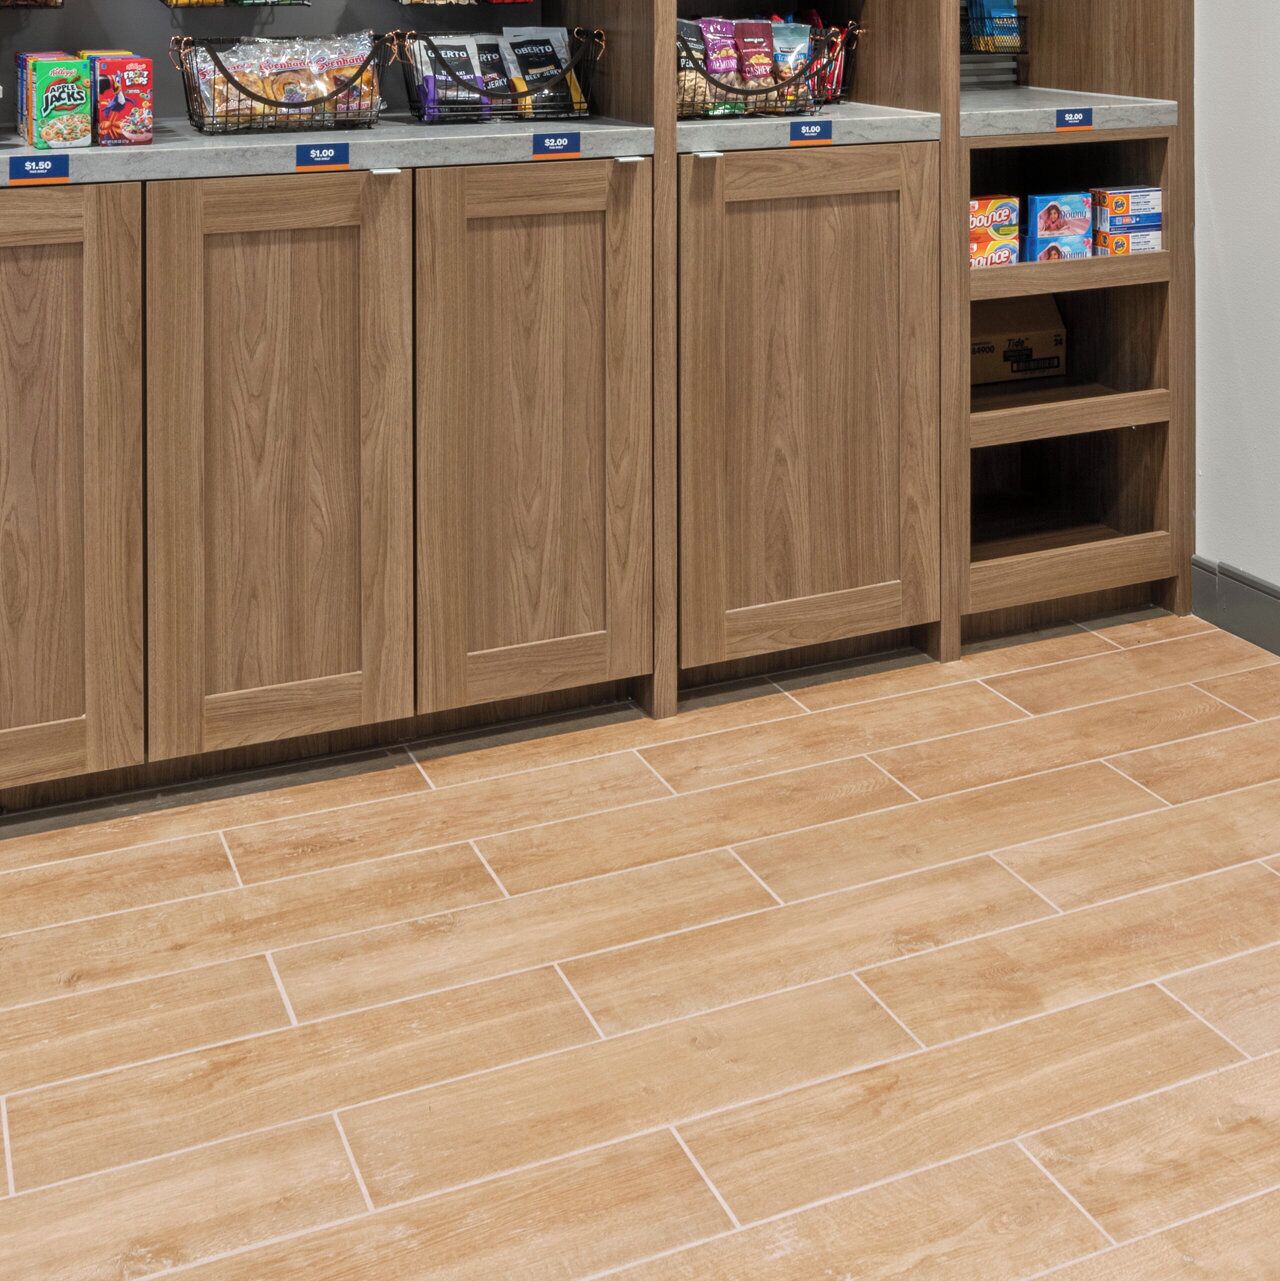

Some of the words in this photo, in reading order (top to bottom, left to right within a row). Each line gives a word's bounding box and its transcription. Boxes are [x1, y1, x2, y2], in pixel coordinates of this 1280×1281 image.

[427, 50, 468, 58] OERTO
[514, 45, 553, 55] OBERTO
[50, 84, 76, 94] APPLE
[42, 90, 85, 113] JACKS
[1065, 113, 1083, 121] $2.00
[801, 125, 820, 134] $1.00
[544, 138, 568, 147] $2.00
[310, 148, 334, 158] $1.00
[24, 161, 52, 170] $1.50
[1113, 200, 1126, 211] Tide
[1060, 208, 1087, 219] Downy
[1113, 240, 1126, 251] Tide
